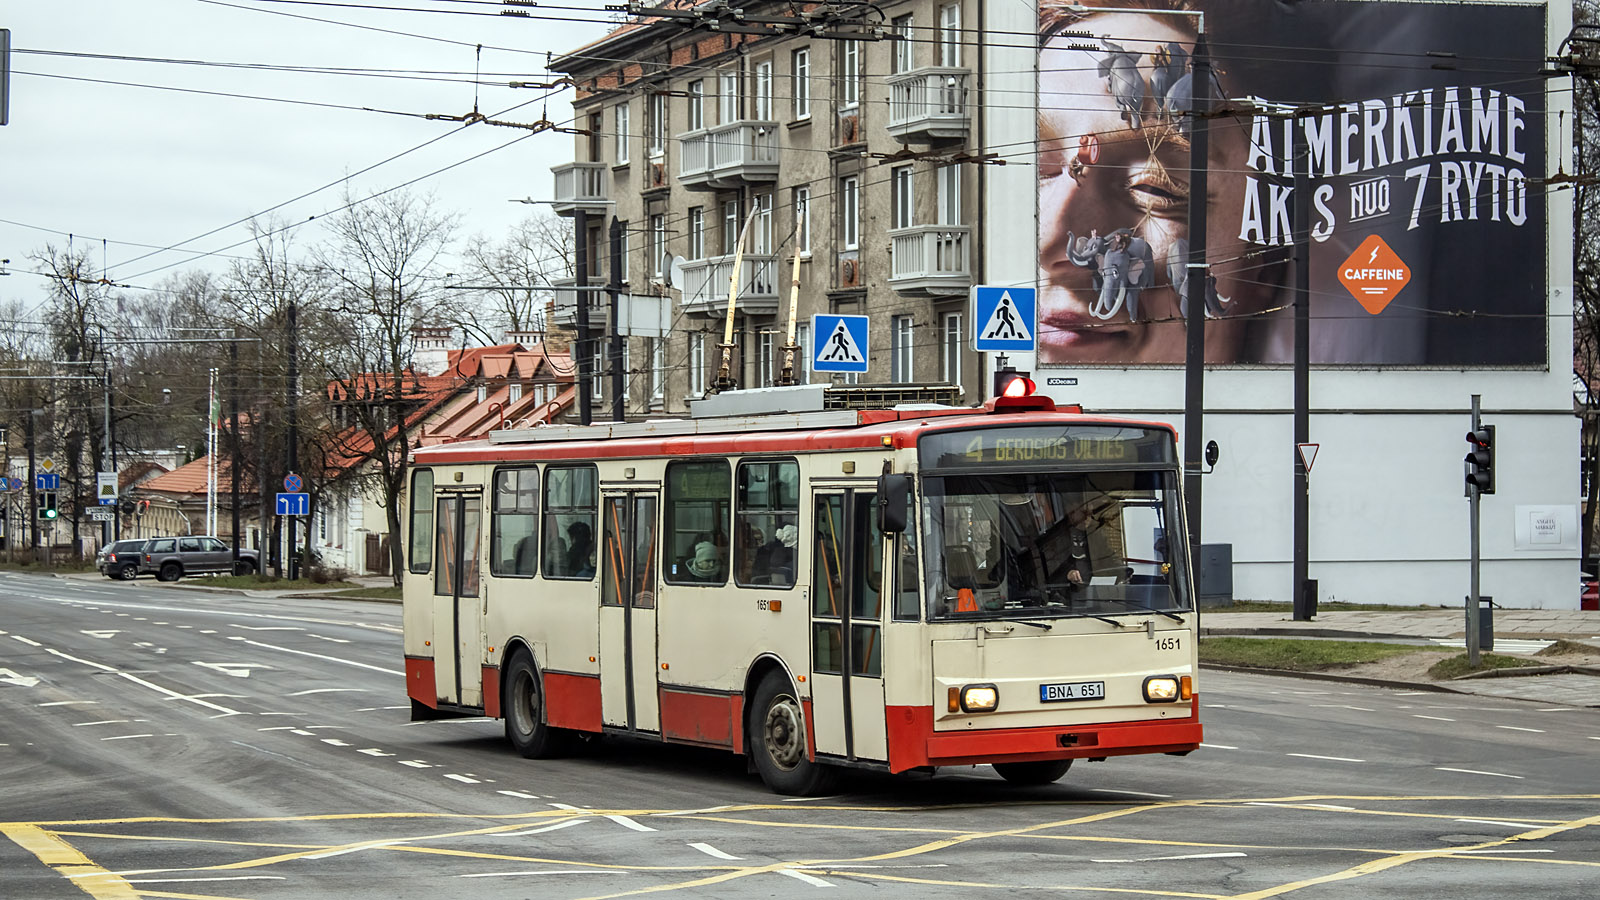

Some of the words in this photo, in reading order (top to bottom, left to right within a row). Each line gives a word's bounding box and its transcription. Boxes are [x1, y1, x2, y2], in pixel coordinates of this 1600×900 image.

[1238, 175, 1336, 247] AKS
[1350, 179, 1391, 219] NUO
[1405, 163, 1431, 231] 7
[1440, 161, 1527, 226] RYTO
[1344, 268, 1404, 281] CAFFEINE
[965, 435, 983, 462] 4
[995, 436, 1067, 461] GEROSIOS
[1073, 436, 1125, 460] VILTIES
[756, 600, 770, 610] 1651
[1155, 638, 1181, 650] 1651
[1049, 686, 1074, 699] BNA
[1081, 684, 1101, 696] 651
